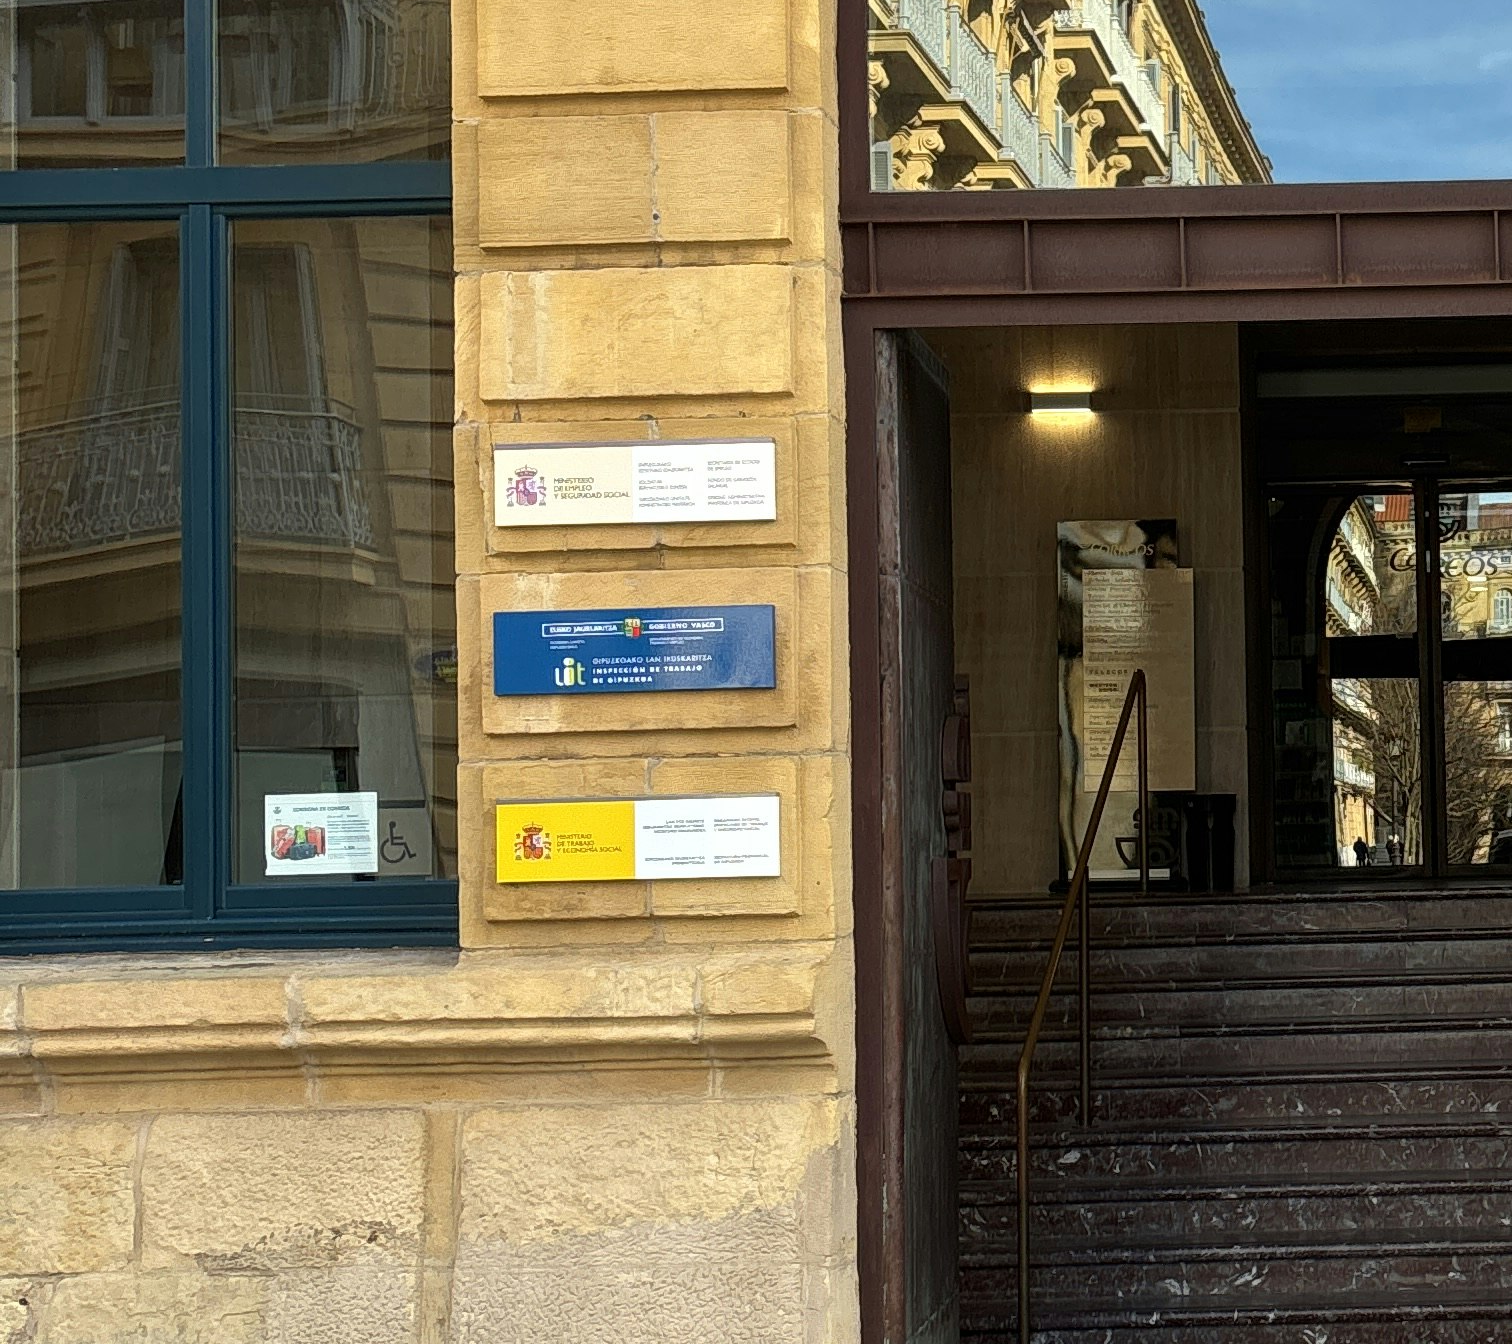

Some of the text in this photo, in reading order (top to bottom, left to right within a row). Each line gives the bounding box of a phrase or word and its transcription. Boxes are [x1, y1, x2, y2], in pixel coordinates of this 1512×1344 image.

[553, 476, 595, 485] MINISTERIO
[603, 491, 630, 499] SOCIAL
[1090, 543, 1155, 556] CORROS
[648, 621, 716, 630] GOBIERNO VASCO
[645, 655, 661, 663] LAN
[663, 664, 703, 672] TRABAJO
[599, 845, 623, 853] SOCIAL
